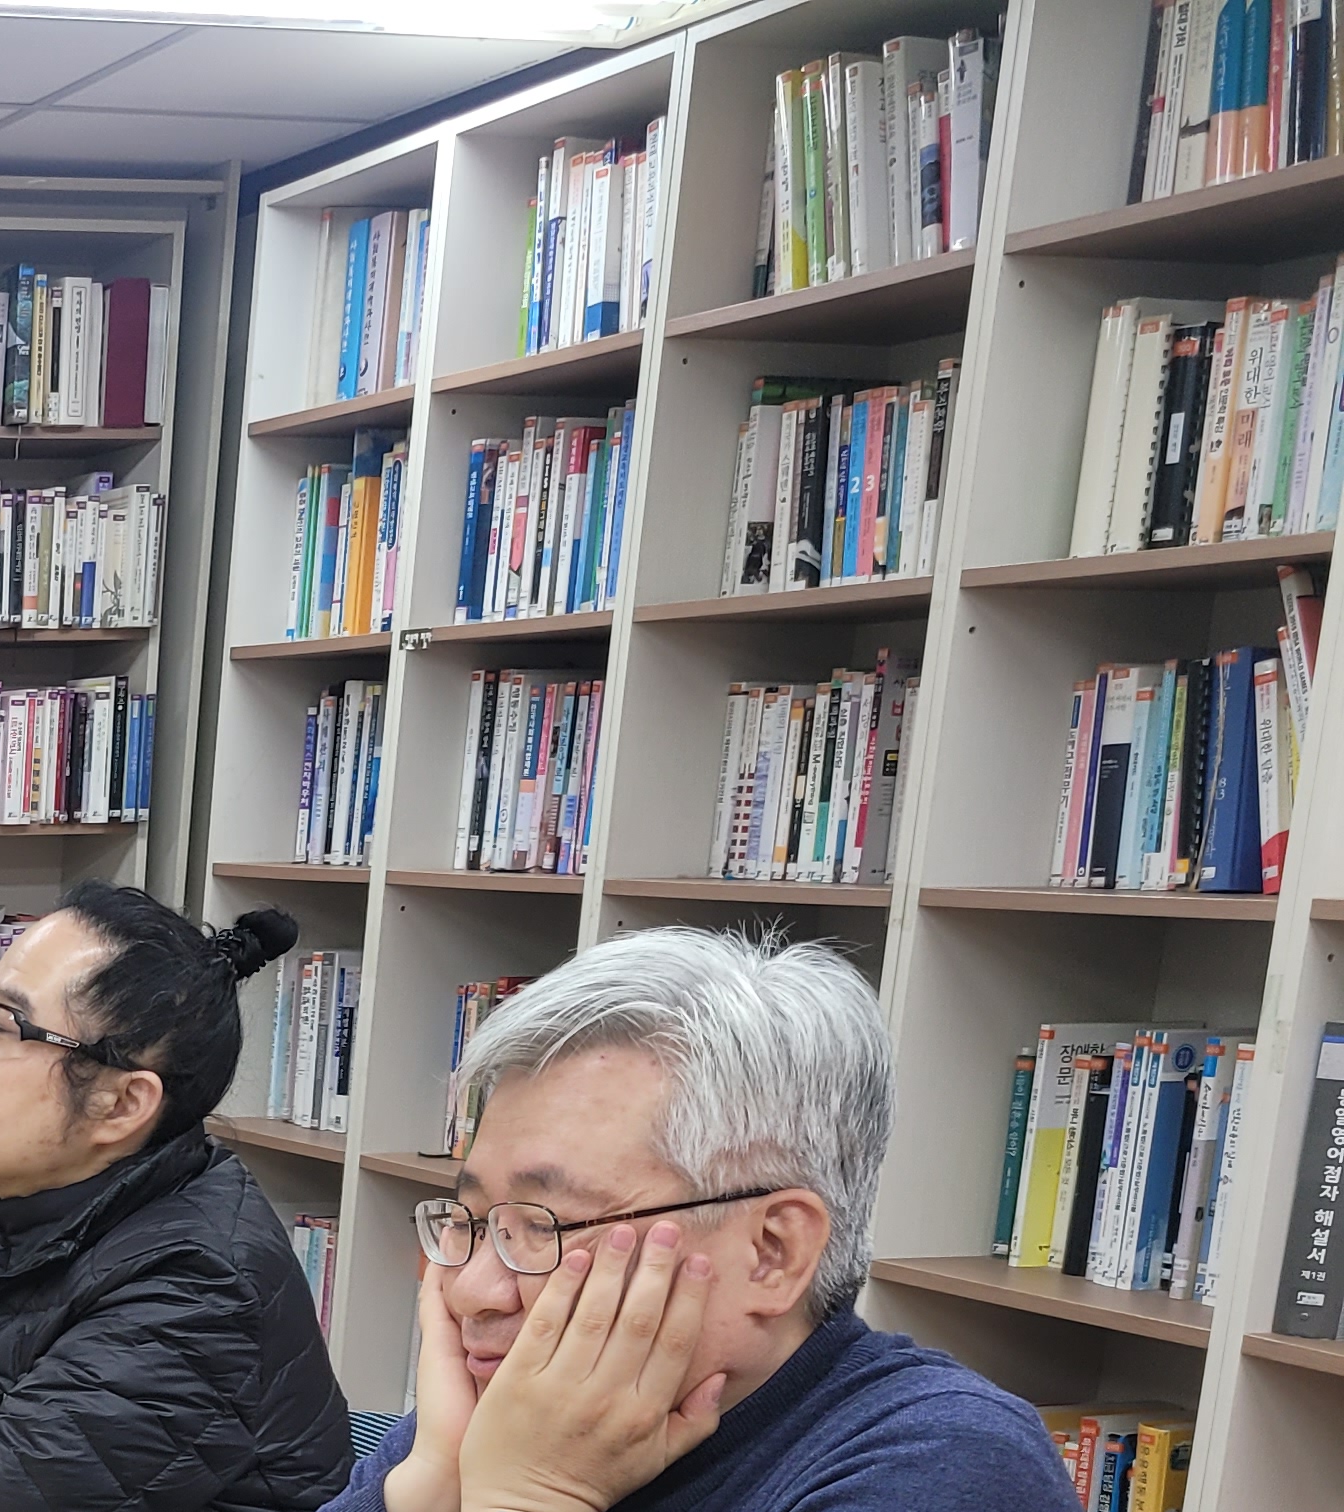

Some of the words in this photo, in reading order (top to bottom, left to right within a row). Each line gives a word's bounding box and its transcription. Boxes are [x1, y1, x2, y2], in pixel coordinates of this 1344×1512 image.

[1173, 26, 1187, 48] 가치
[1244, 347, 1264, 405] 위대한
[1237, 411, 1256, 449] 미래
[849, 476, 861, 494] 2
[864, 475, 875, 492] 3
[1294, 647, 1304, 670] WORLD
[1297, 671, 1308, 695] GAMES
[1260, 717, 1273, 756] 위대한
[1068, 1107, 1079, 1124] 버니
[1307, 1208, 1335, 1265] 해설서
[1300, 1269, 1327, 1282] 제1권
